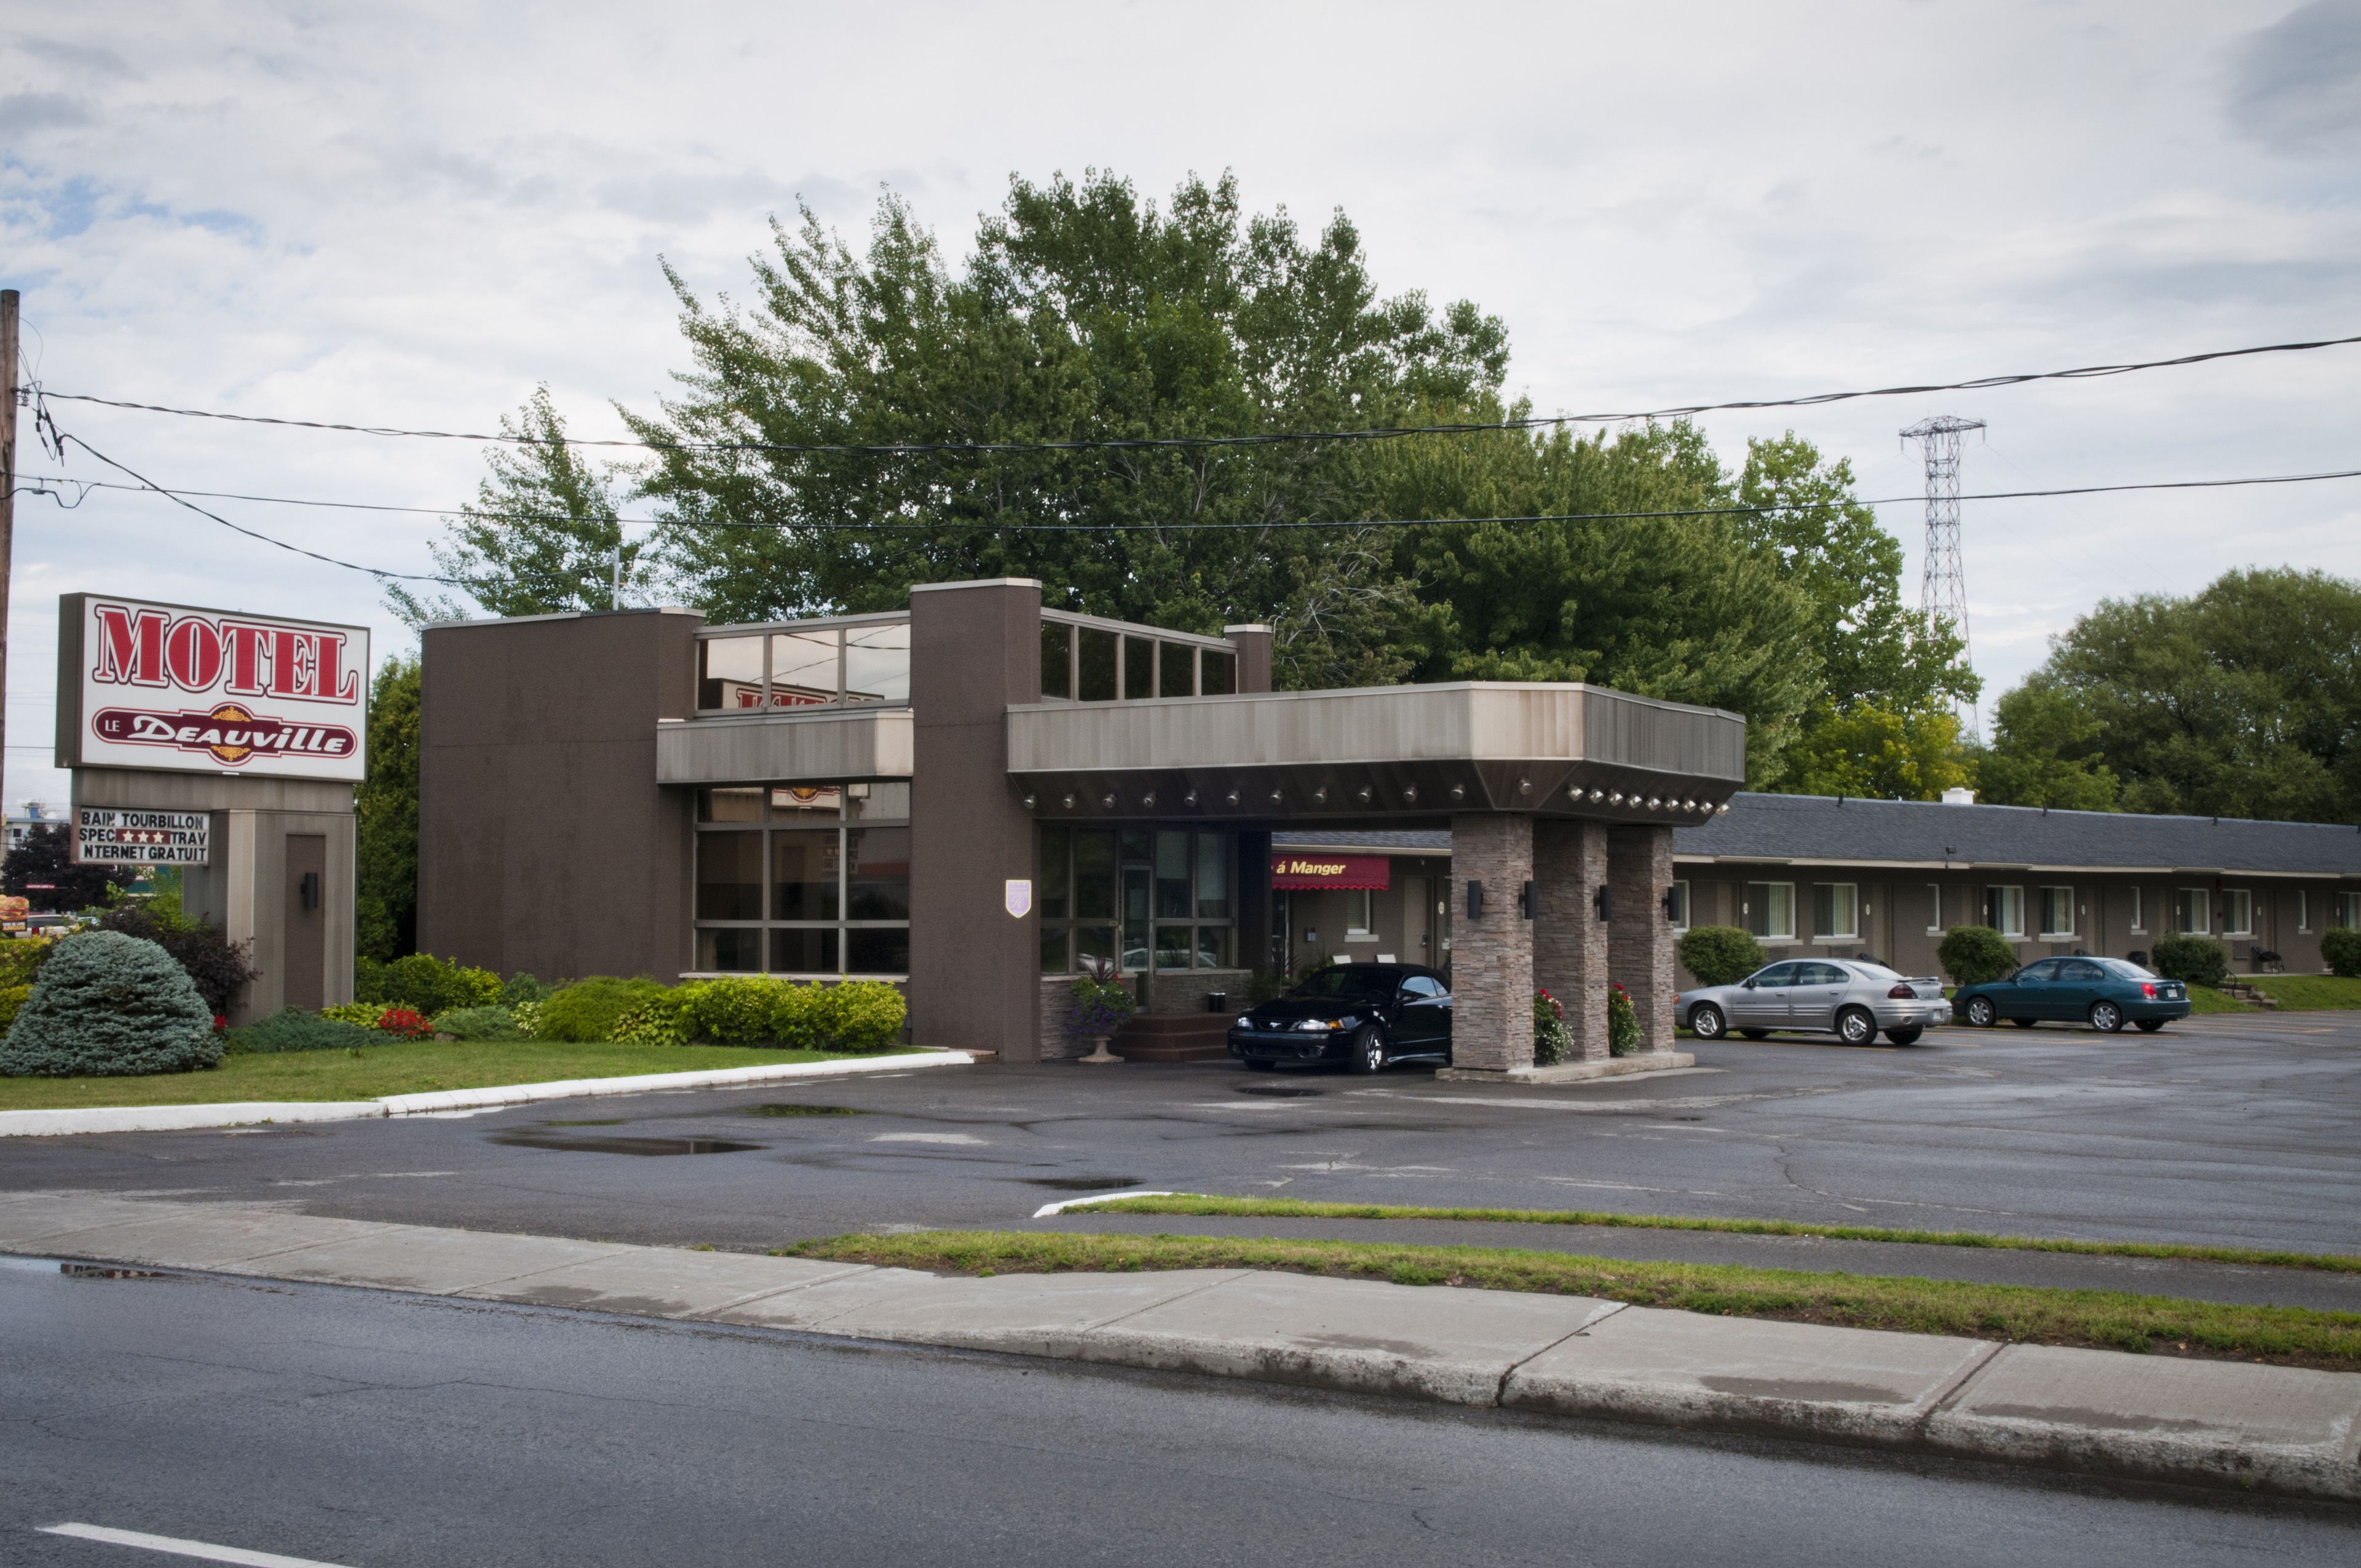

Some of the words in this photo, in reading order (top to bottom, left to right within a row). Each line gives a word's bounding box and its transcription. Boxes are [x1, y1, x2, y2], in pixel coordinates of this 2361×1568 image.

[92, 604, 358, 705] MOTEL
[105, 719, 120, 732] LE
[81, 812, 116, 826] BAIN
[122, 813, 204, 829] TOURBILLON
[79, 828, 116, 841] SPEC
[170, 831, 207, 845] TRAV
[84, 844, 146, 859] NTERNET
[148, 846, 206, 861] GRATUIT
[1290, 861, 1346, 876] Manger
